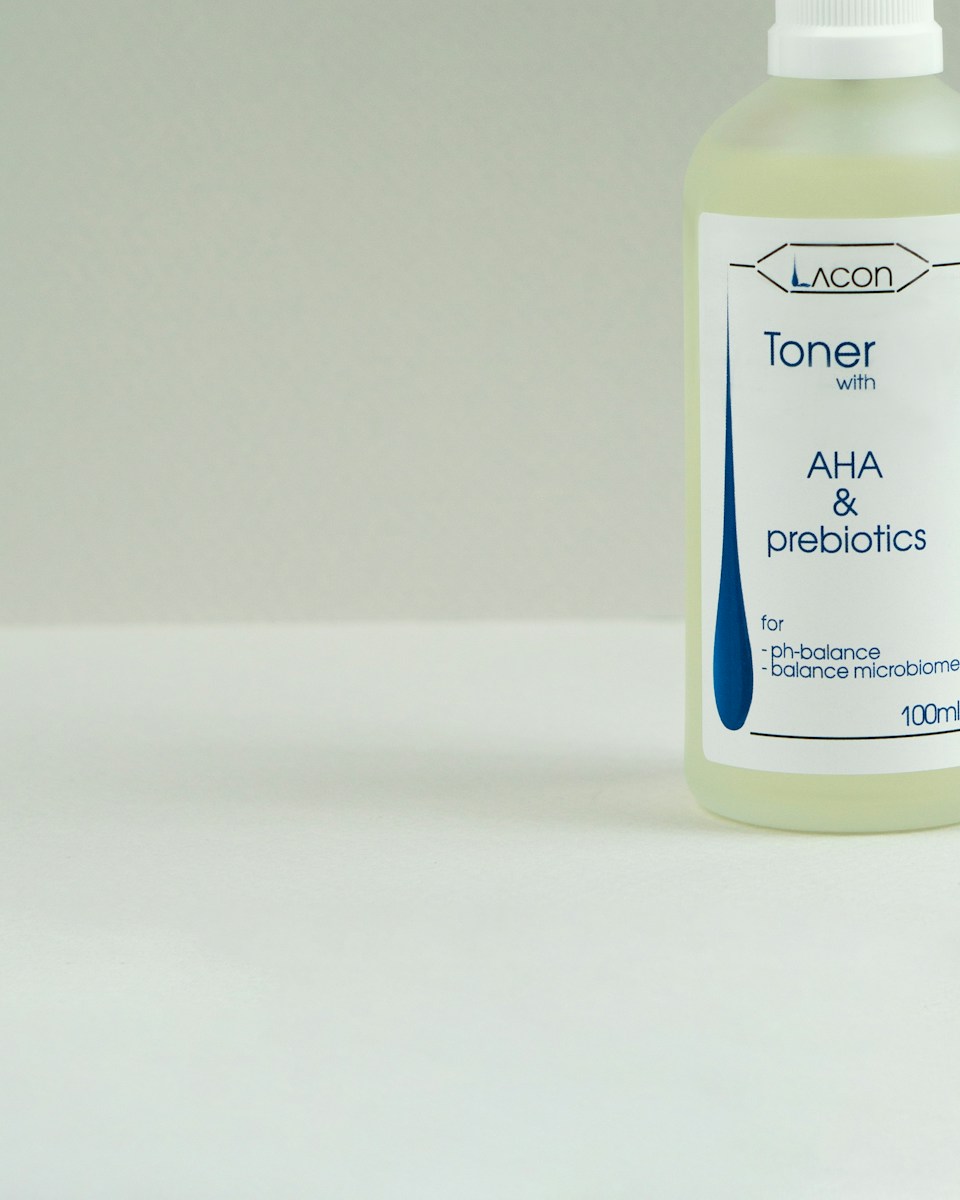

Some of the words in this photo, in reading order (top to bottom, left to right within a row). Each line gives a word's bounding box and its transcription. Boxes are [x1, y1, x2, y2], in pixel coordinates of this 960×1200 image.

[763, 330, 876, 369] Toner
[835, 373, 876, 391] with
[806, 450, 884, 480] AHA
[832, 487, 859, 517] &
[767, 524, 927, 558] prebiotics
[760, 614, 785, 632] for
[770, 641, 881, 661] ph-balance
[770, 661, 850, 680] balance
[853, 657, 960, 680] microbiome
[901, 699, 960, 727] 100ml
